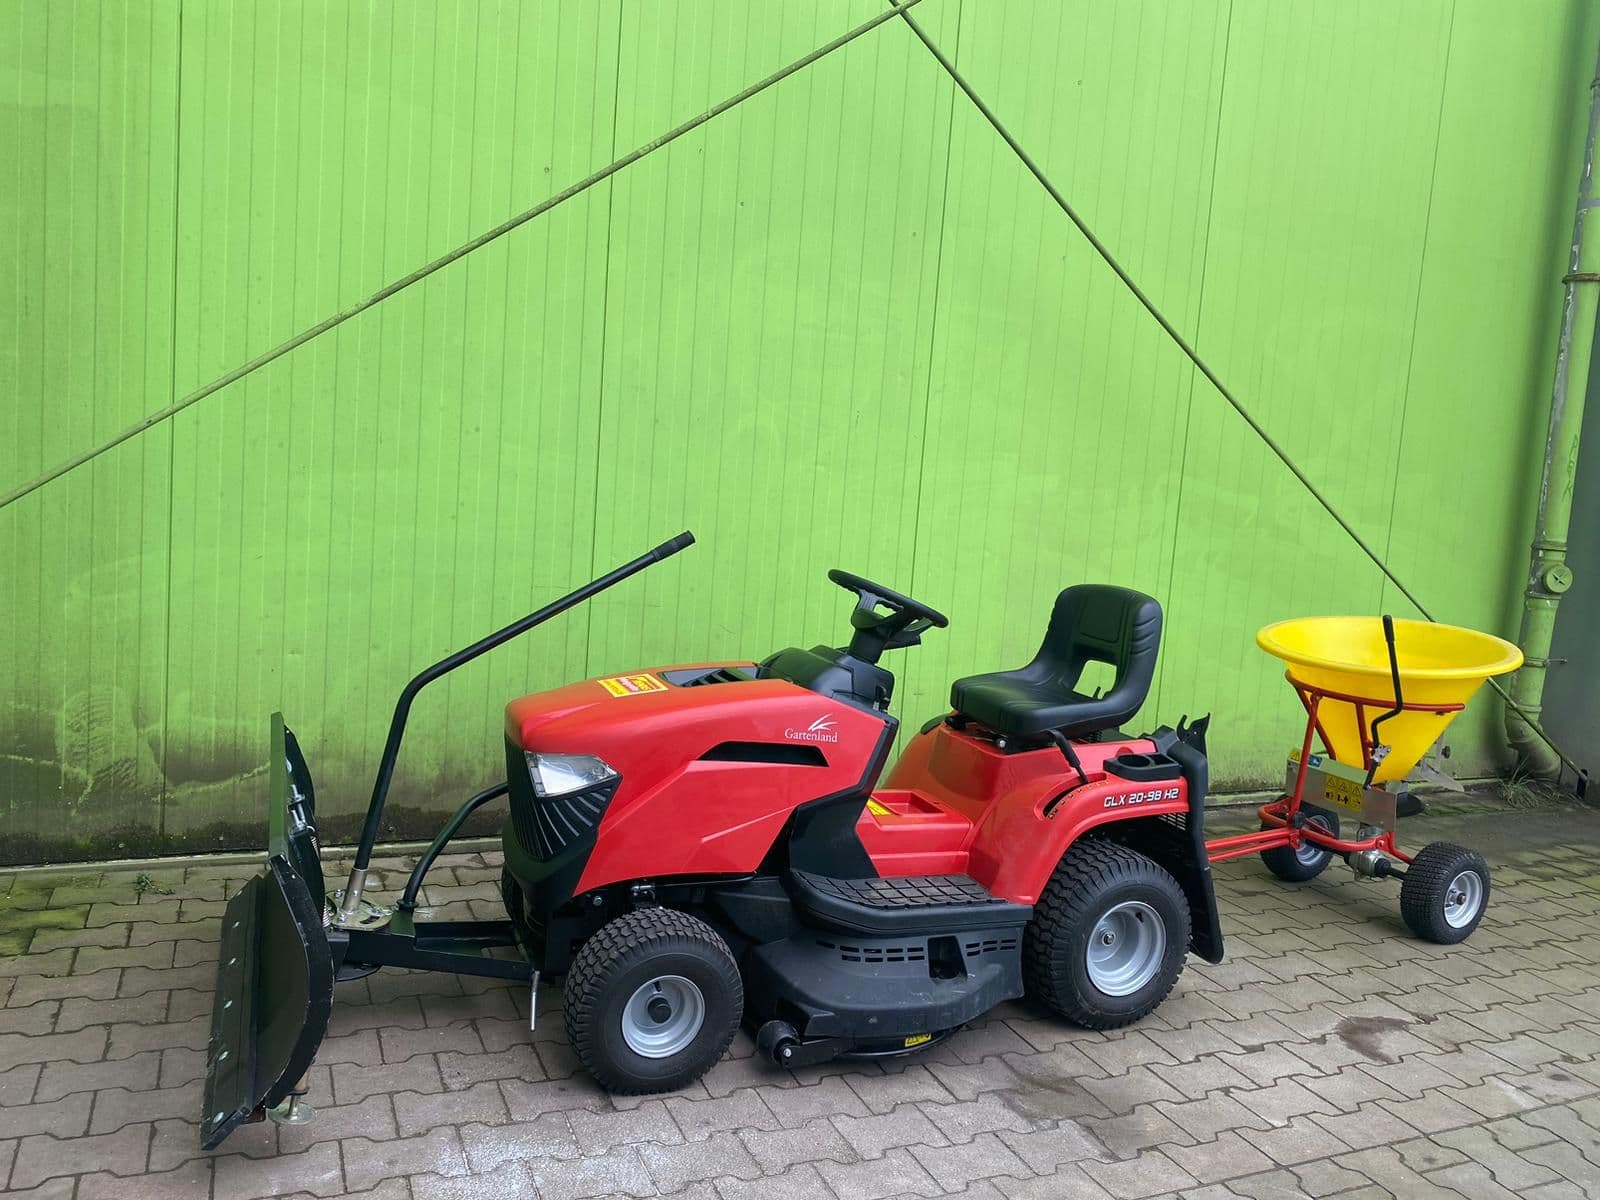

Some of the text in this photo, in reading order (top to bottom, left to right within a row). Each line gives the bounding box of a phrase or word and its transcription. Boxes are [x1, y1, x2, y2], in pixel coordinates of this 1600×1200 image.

[784, 727, 838, 743] Gartenland
[1103, 794, 1126, 808] GLX
[1164, 788, 1179, 800] H2
